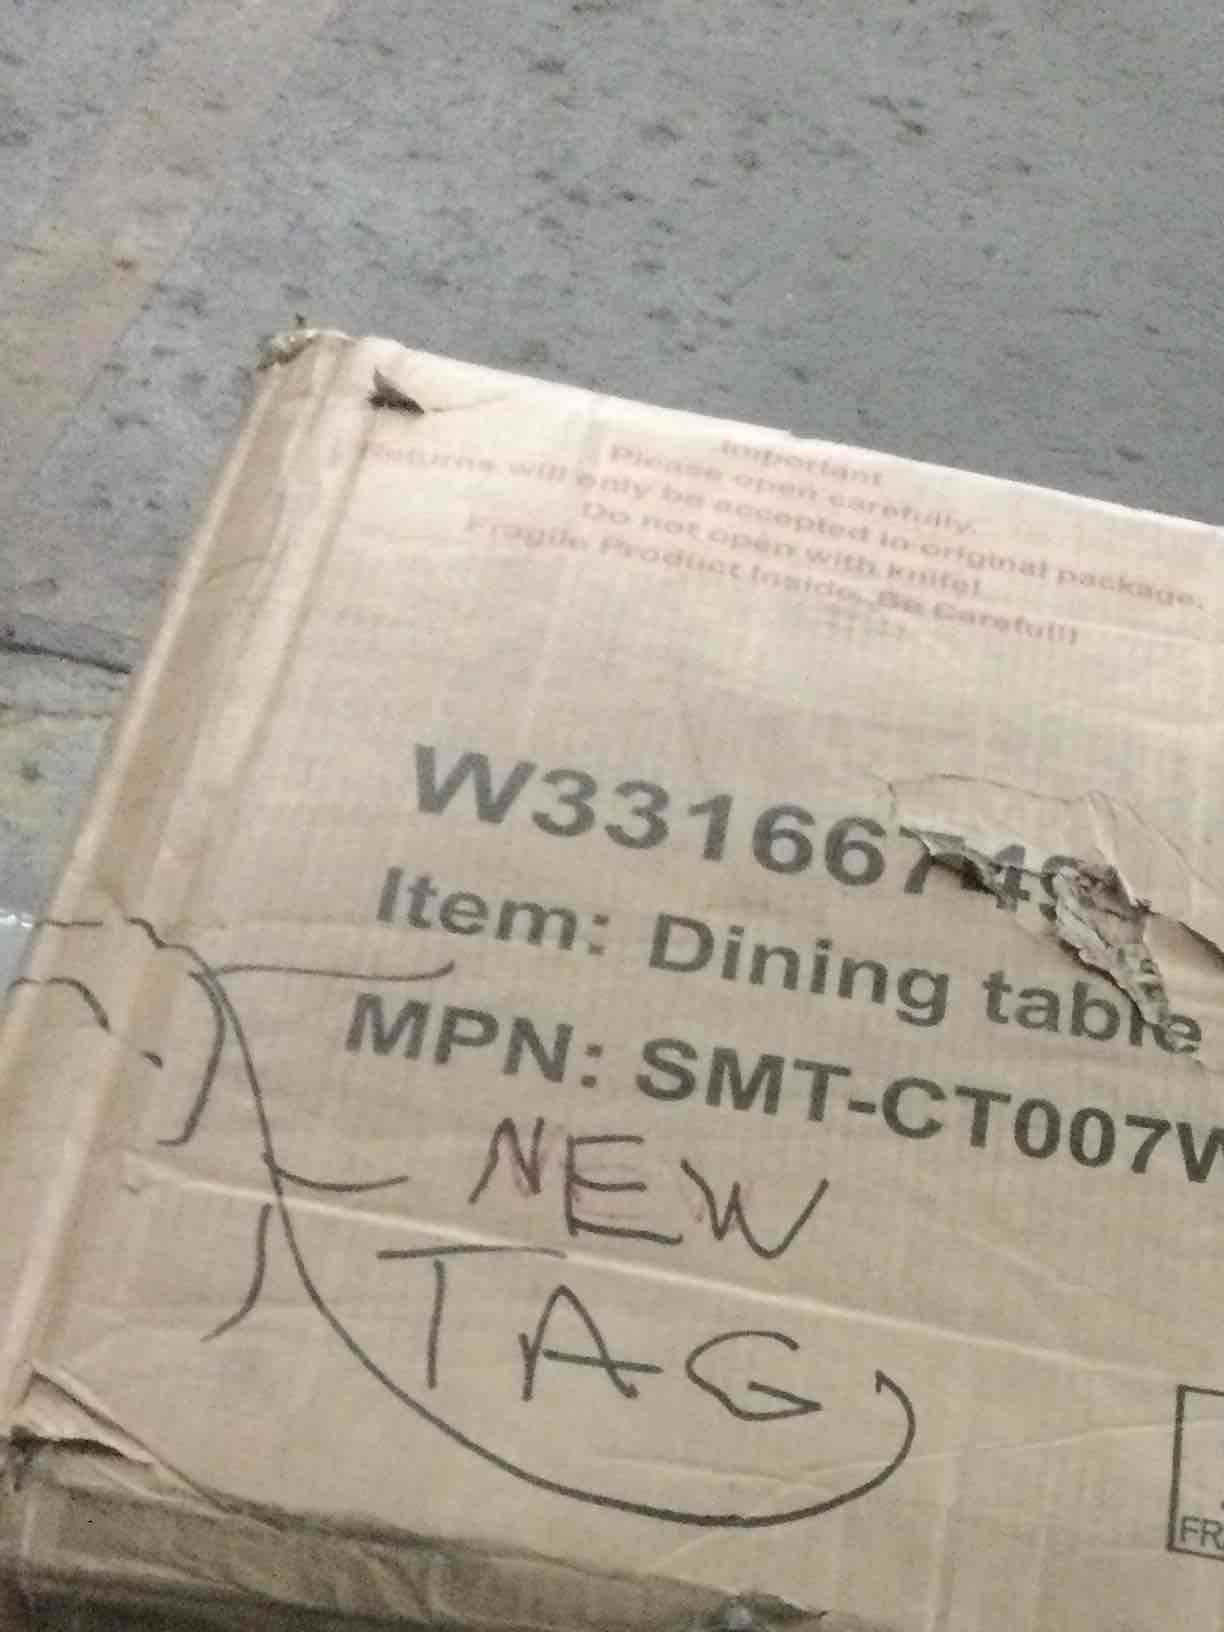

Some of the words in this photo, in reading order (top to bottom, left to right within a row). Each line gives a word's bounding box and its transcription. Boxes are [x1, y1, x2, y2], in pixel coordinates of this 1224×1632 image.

[608, 443, 724, 482] Please
[731, 471, 818, 503] open
[829, 493, 978, 535] carefully.
[720, 438, 882, 487] Important
[466, 512, 588, 553] Fragile
[600, 535, 742, 583] Product
[876, 590, 923, 615] Be
[509, 459, 566, 482] will
[576, 470, 654, 501] only
[662, 482, 705, 511] be
[713, 498, 871, 546] accepted
[879, 527, 911, 552] in
[920, 540, 1048, 581] original
[1057, 567, 1207, 611] package.
[581, 502, 632, 526] Do
[641, 515, 700, 539] not
[708, 529, 797, 560] open
[805, 545, 878, 577] with
[376, 867, 608, 956] Item:
[649, 914, 951, 1028] Dining
[981, 970, 1202, 1055] table
[344, 992, 602, 1090] MPN:
[469, 1116, 828, 1258] NEW
[377, 1244, 822, 1422] TAG
